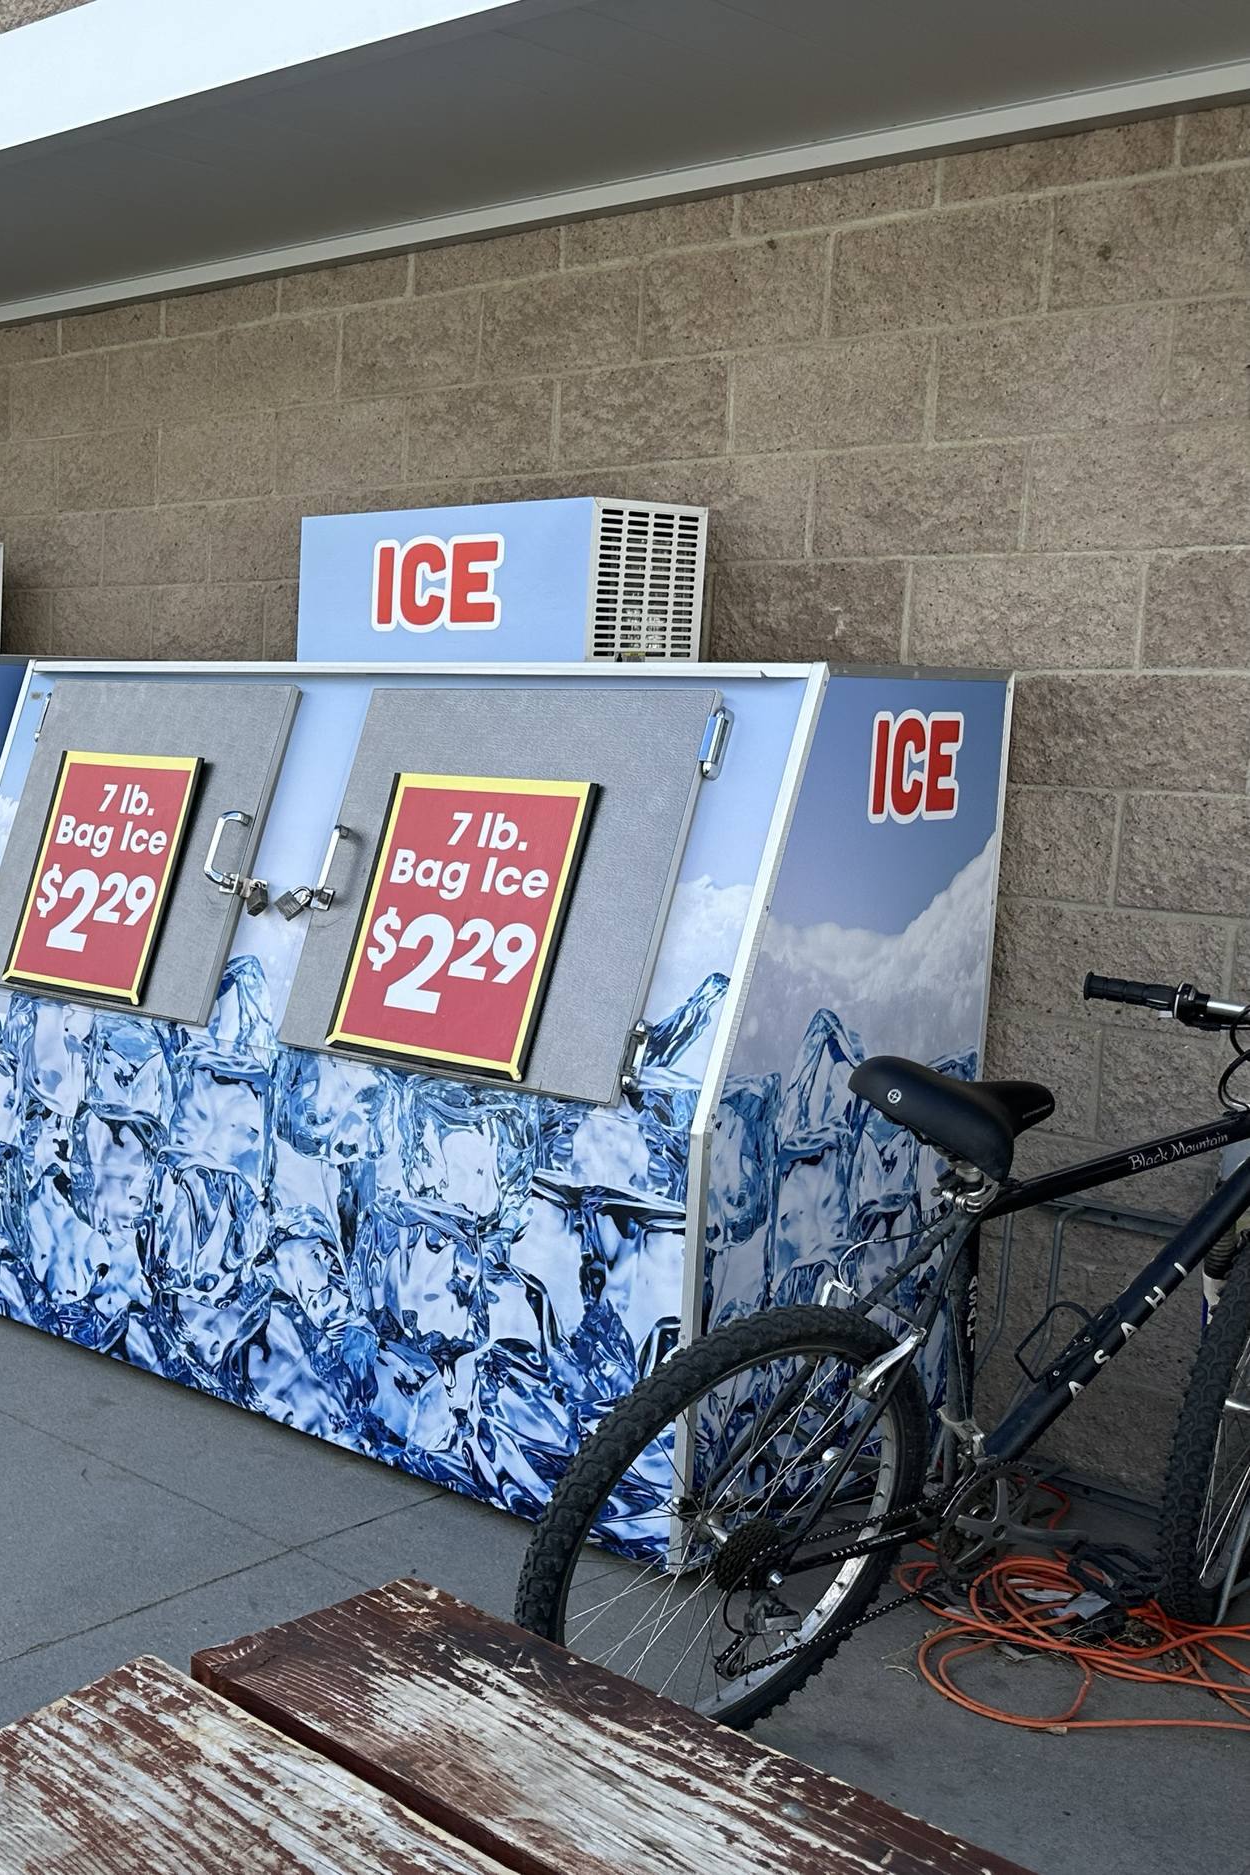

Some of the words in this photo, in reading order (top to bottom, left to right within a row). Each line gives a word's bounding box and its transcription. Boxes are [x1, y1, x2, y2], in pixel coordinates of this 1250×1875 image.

[369, 533, 504, 633] ICE
[869, 711, 962, 822] ICE
[97, 783, 118, 813] 7
[119, 784, 155, 817] lb.
[55, 814, 110, 857] Bag
[120, 821, 167, 856] Ice
[446, 812, 473, 846] 7
[476, 811, 528, 851] lb.
[389, 849, 471, 901] Bag
[481, 856, 549, 899] Ice
[1128, 1147, 1168, 1170] Black
[1170, 1132, 1228, 1160] Mountain
[967, 1275, 978, 1352] ASAHI
[1069, 1262, 1188, 1399] ASAHI
